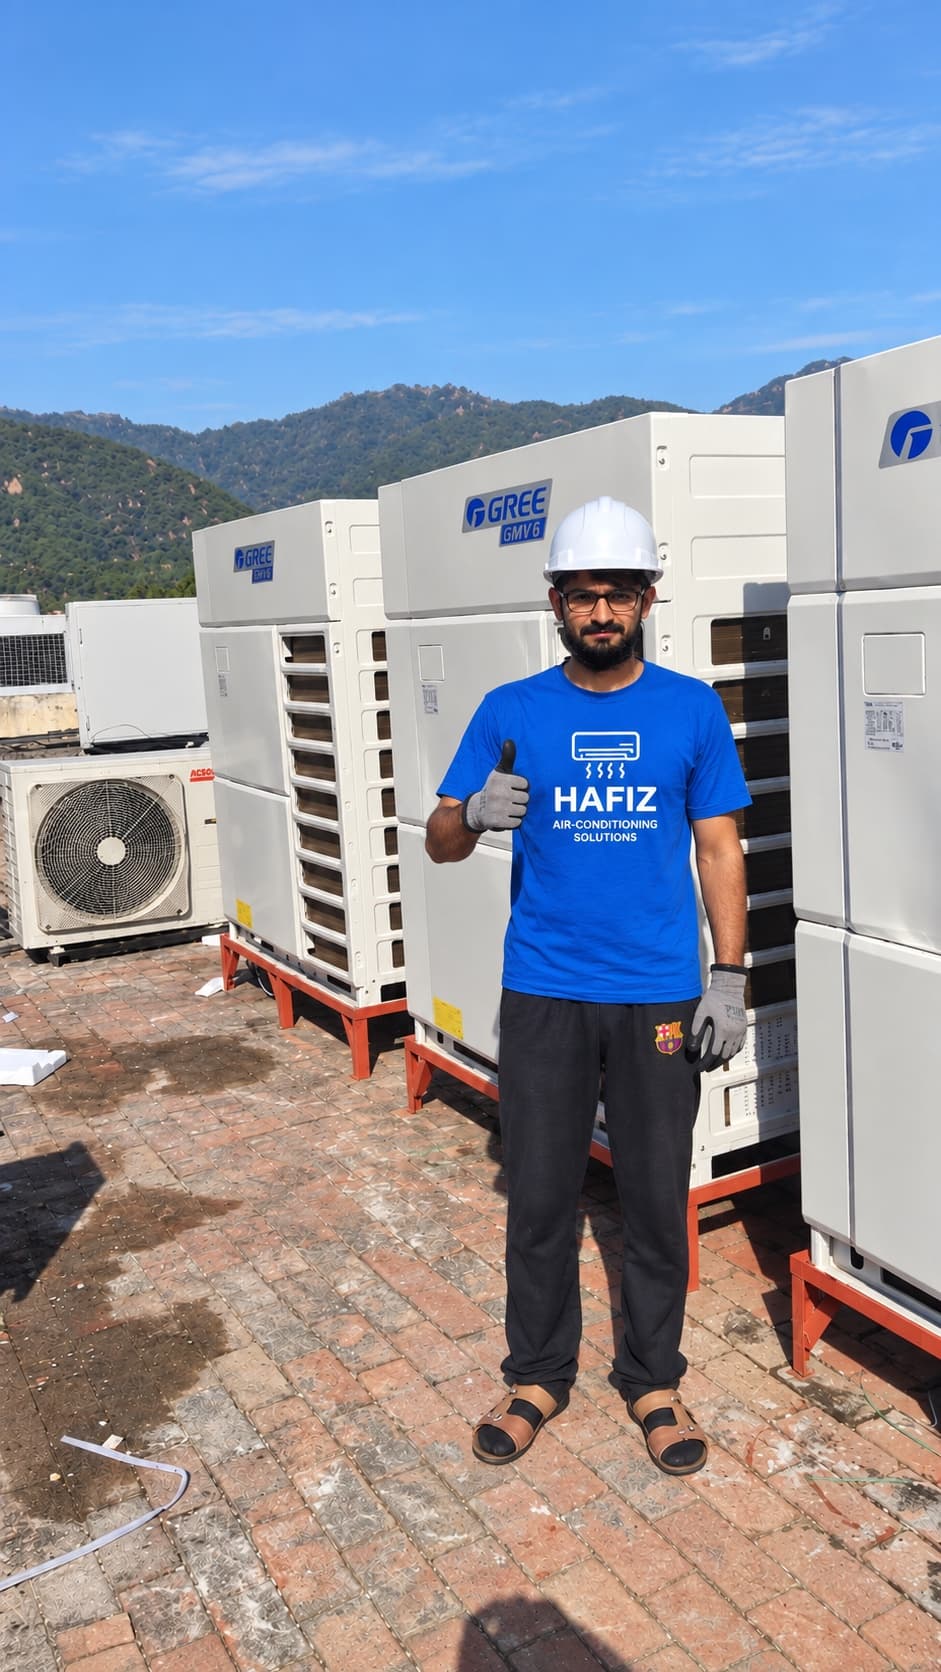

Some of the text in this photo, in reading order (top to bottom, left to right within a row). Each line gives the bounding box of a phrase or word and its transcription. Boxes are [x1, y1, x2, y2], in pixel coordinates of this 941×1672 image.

[488, 487, 546, 522] GREE
[503, 523, 532, 541] GMV
[246, 546, 272, 566] GREE
[554, 786, 657, 812] HAFIZ
[552, 819, 658, 830] AIR-CONDITIONING
[573, 832, 637, 842] SOLUTIONS
